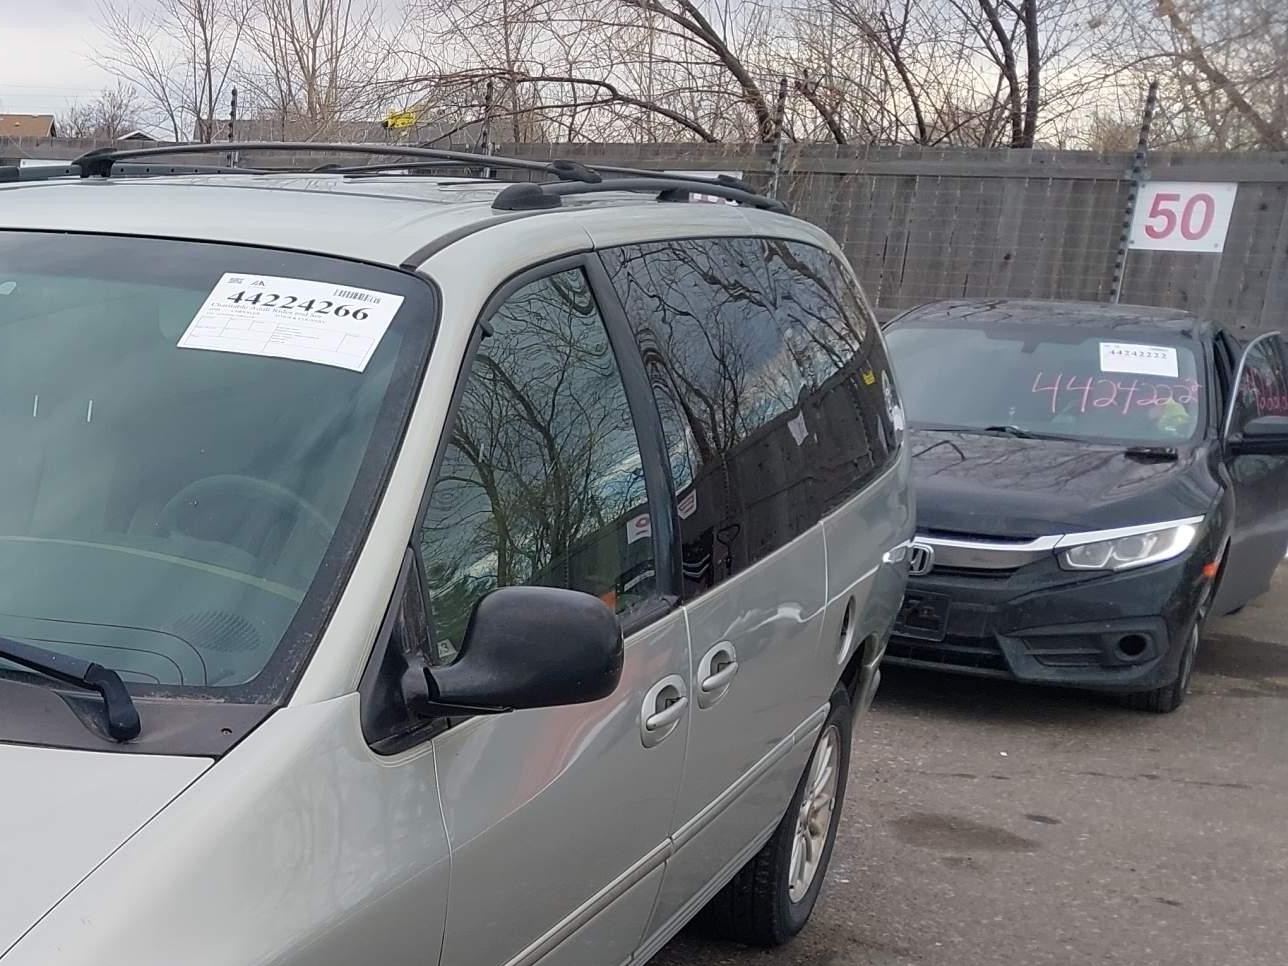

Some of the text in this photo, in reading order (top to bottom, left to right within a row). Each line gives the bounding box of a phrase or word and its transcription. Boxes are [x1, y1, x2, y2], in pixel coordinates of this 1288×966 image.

[1144, 192, 1216, 241] 50
[226, 290, 374, 320] 44224266
[1110, 349, 1168, 359] 44242222
